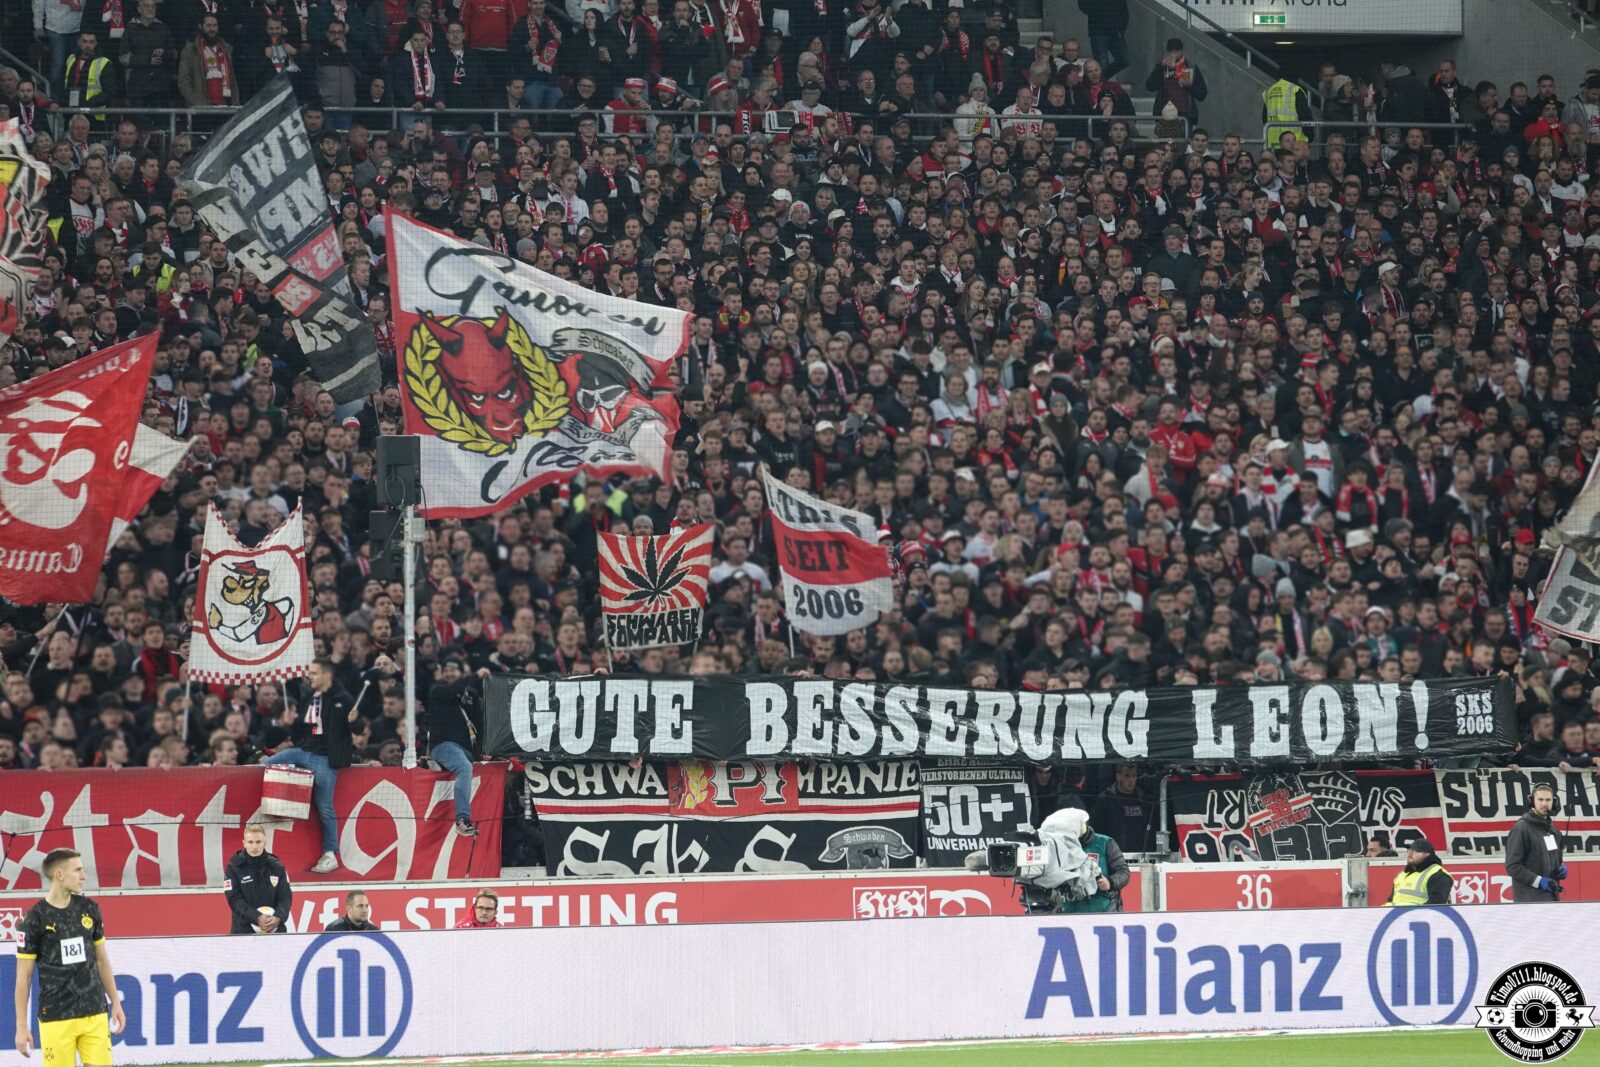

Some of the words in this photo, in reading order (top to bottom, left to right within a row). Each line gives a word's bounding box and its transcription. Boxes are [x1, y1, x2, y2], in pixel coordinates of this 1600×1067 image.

[783, 535, 850, 572] SEIT
[793, 584, 864, 620] 2006
[606, 607, 701, 630] SCHWABEN
[607, 622, 701, 647] KOMPANIE
[1455, 691, 1492, 716] SKS
[510, 678, 695, 755] GUTE
[745, 679, 1150, 761] BESSERUNG
[1192, 679, 1429, 758] LEON!
[1456, 714, 1494, 735] 2006
[921, 770, 987, 782] VERSTORBENEN
[988, 769, 1023, 780] ULTRAS
[923, 783, 1036, 836] 50+1
[340, 775, 482, 881] 97
[843, 831, 886, 844] Schwaben
[1236, 873, 1273, 910] 36
[63, 943, 82, 957] 1&1
[1024, 922, 1344, 1019] Allianz
